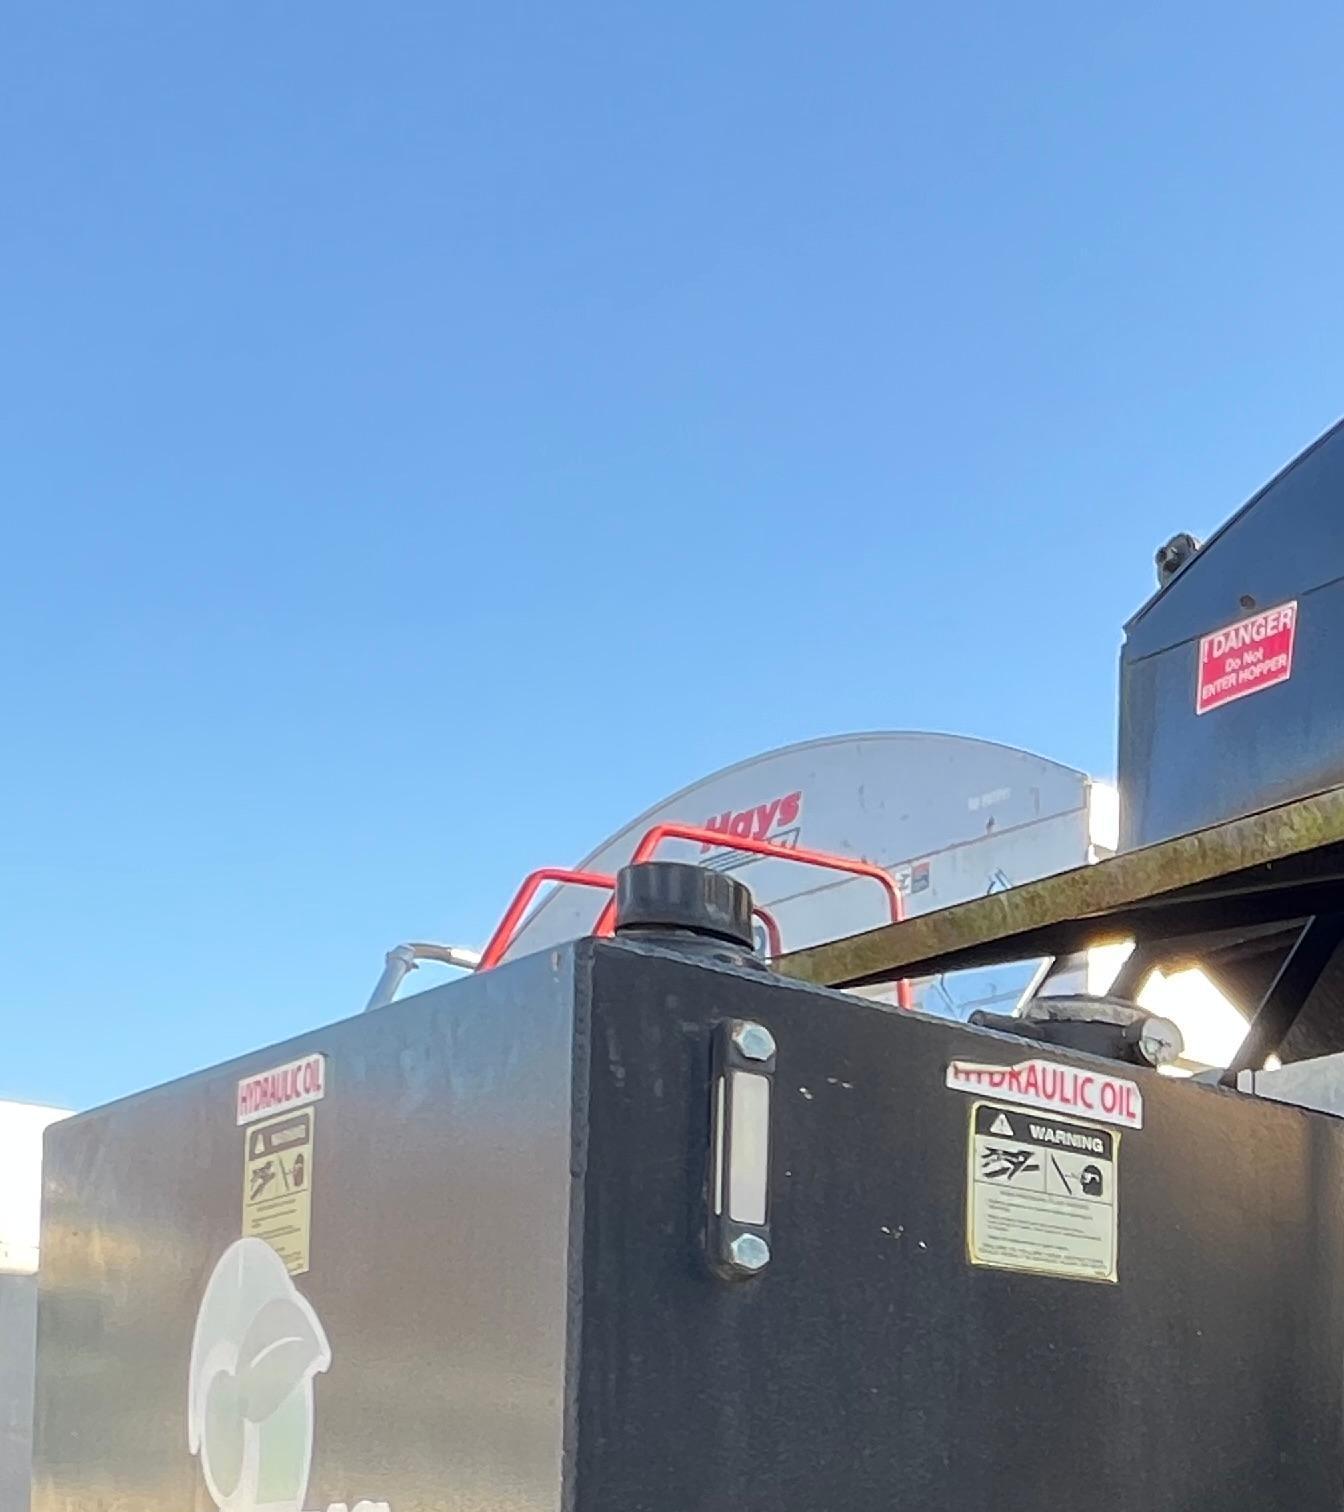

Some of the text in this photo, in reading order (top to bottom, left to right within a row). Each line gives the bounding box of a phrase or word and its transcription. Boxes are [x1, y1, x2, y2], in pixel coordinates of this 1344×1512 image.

[1212, 607, 1293, 659] DANGER
[1202, 653, 1288, 700] ENTER HOPPER
[700, 791, 801, 854] Hays
[239, 1059, 322, 1116] HYDRAULIC OIL
[1100, 1081, 1137, 1120] OIL
[1029, 1124, 1105, 1154] WARNING
